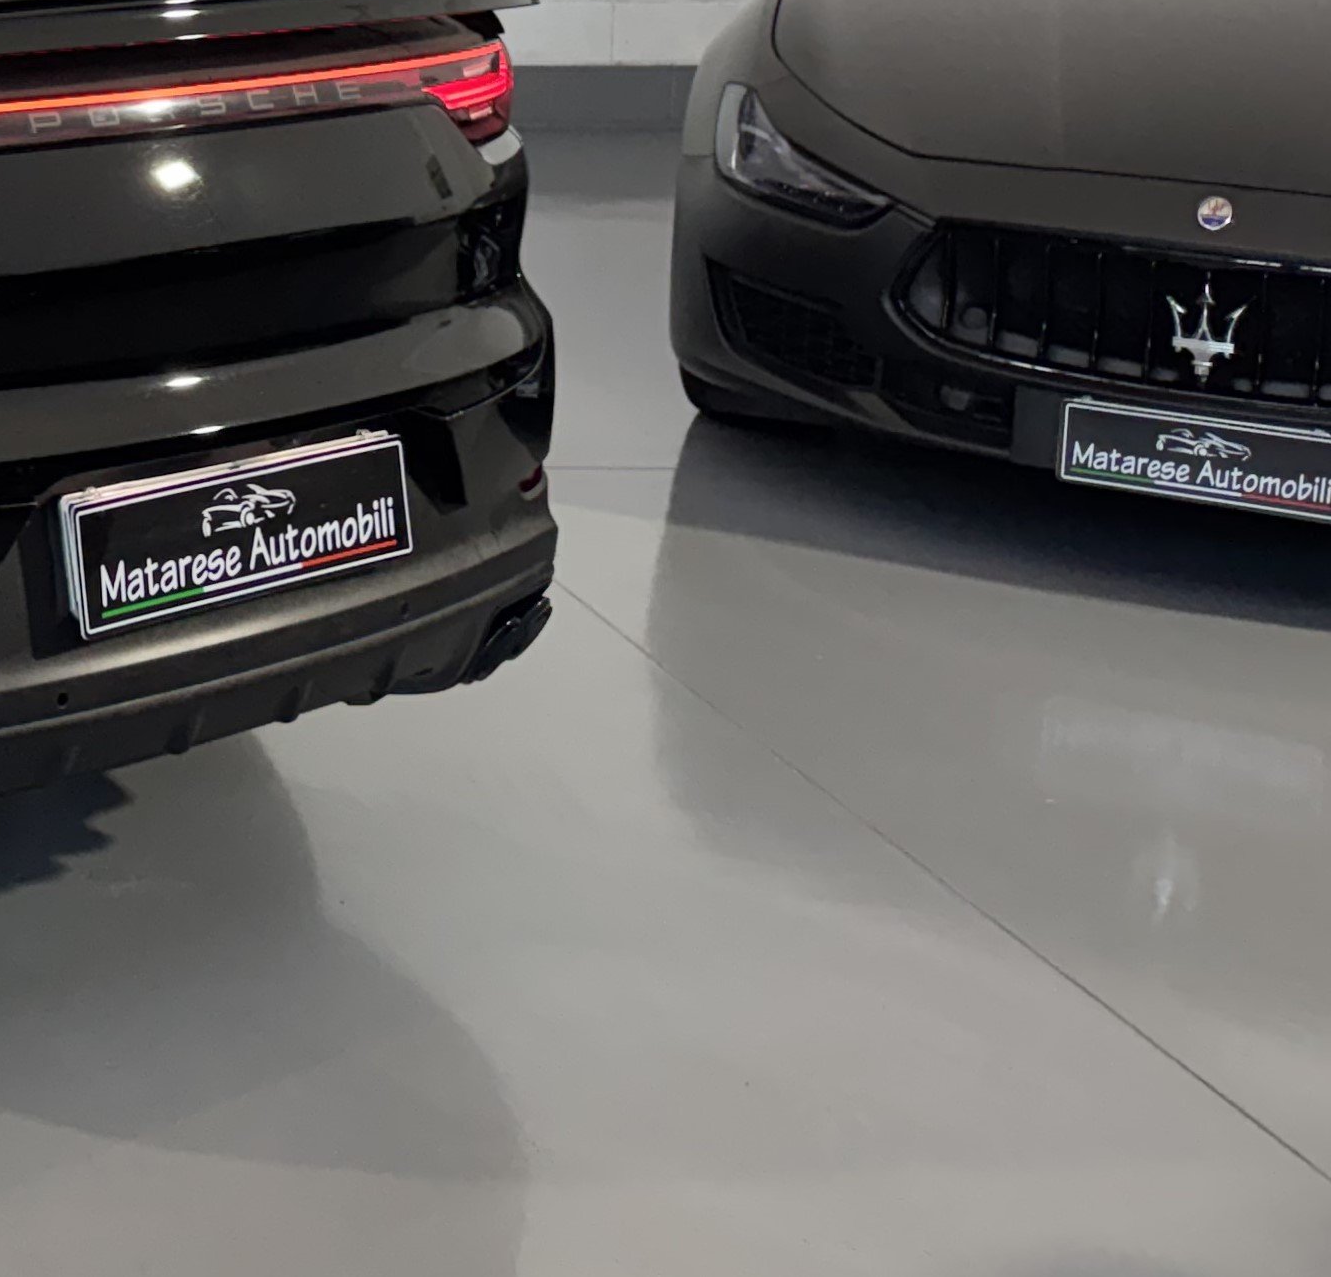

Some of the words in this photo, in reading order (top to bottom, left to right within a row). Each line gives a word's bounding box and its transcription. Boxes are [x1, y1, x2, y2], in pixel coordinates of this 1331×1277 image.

[1071, 440, 1191, 482] Matarese
[1196, 459, 1331, 504] Automobili
[100, 545, 242, 607] Matarese
[249, 496, 396, 571] Automobili
